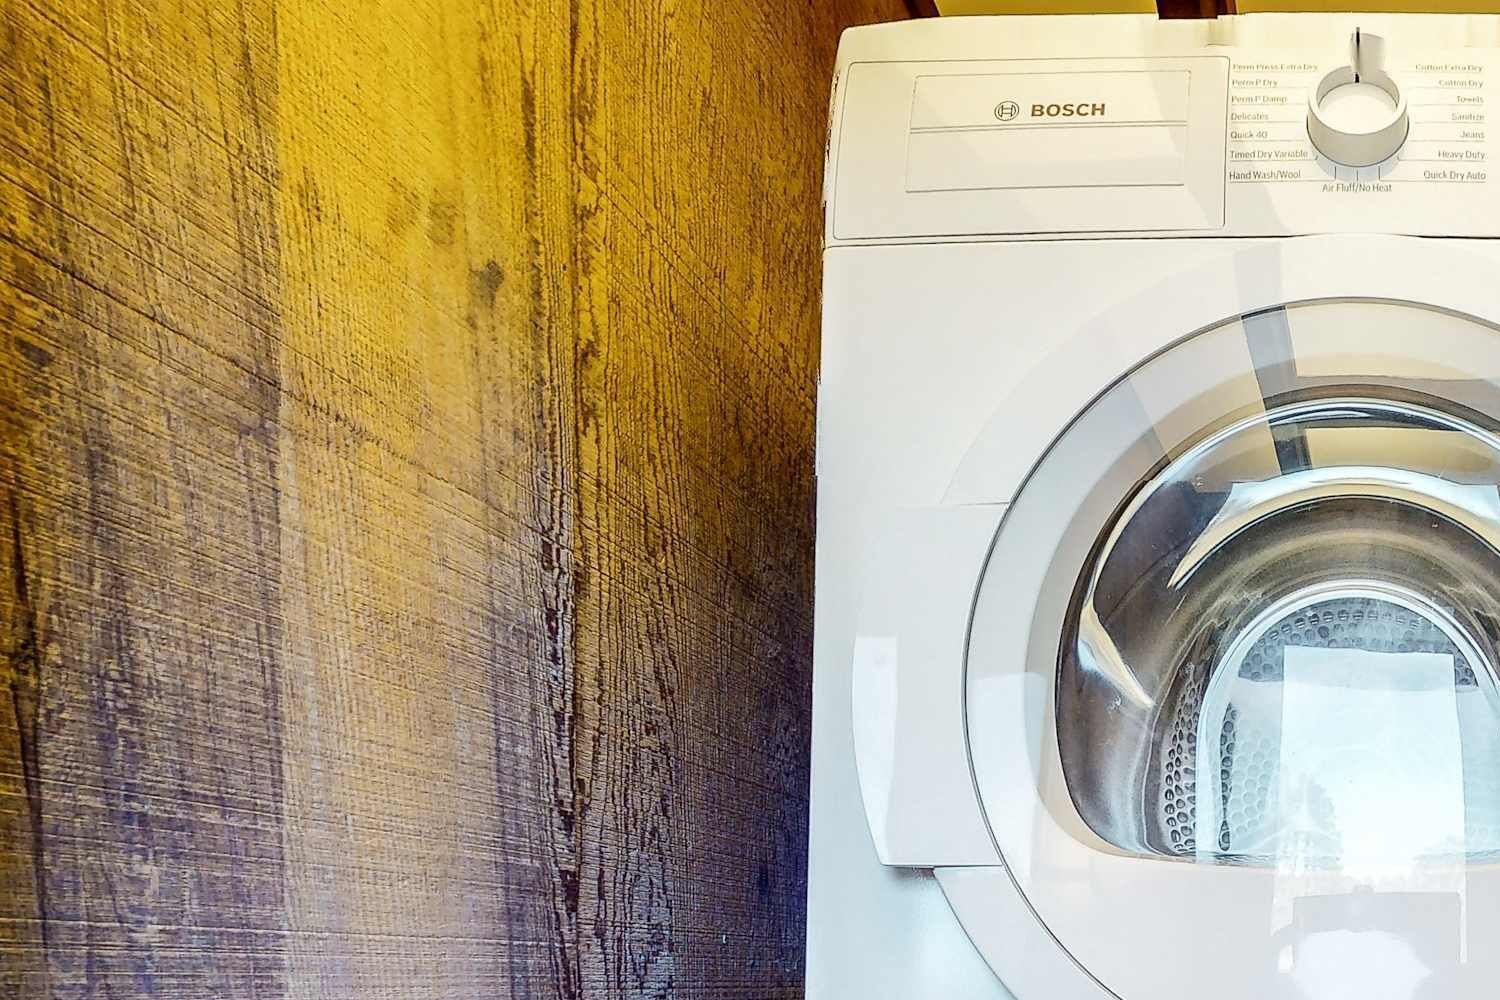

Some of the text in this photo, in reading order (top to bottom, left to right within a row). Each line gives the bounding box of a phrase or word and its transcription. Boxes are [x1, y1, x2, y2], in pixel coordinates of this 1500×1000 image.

[1456, 95, 1484, 104] Towels
[1030, 102, 1106, 118] BOSCH
[1230, 112, 1269, 121] Delicates
[1451, 112, 1485, 121] Sanitize
[1230, 130, 1268, 139] Quick 40
[1459, 130, 1485, 139] Jeans
[1229, 149, 1309, 160] Timed Dry Variable
[1438, 150, 1486, 160] Heavy Duty
[1229, 169, 1301, 180] Hand Wash/Wool
[1423, 169, 1487, 181] Quick Dry Auto
[1322, 183, 1393, 193] Air Fluff/No Heat
